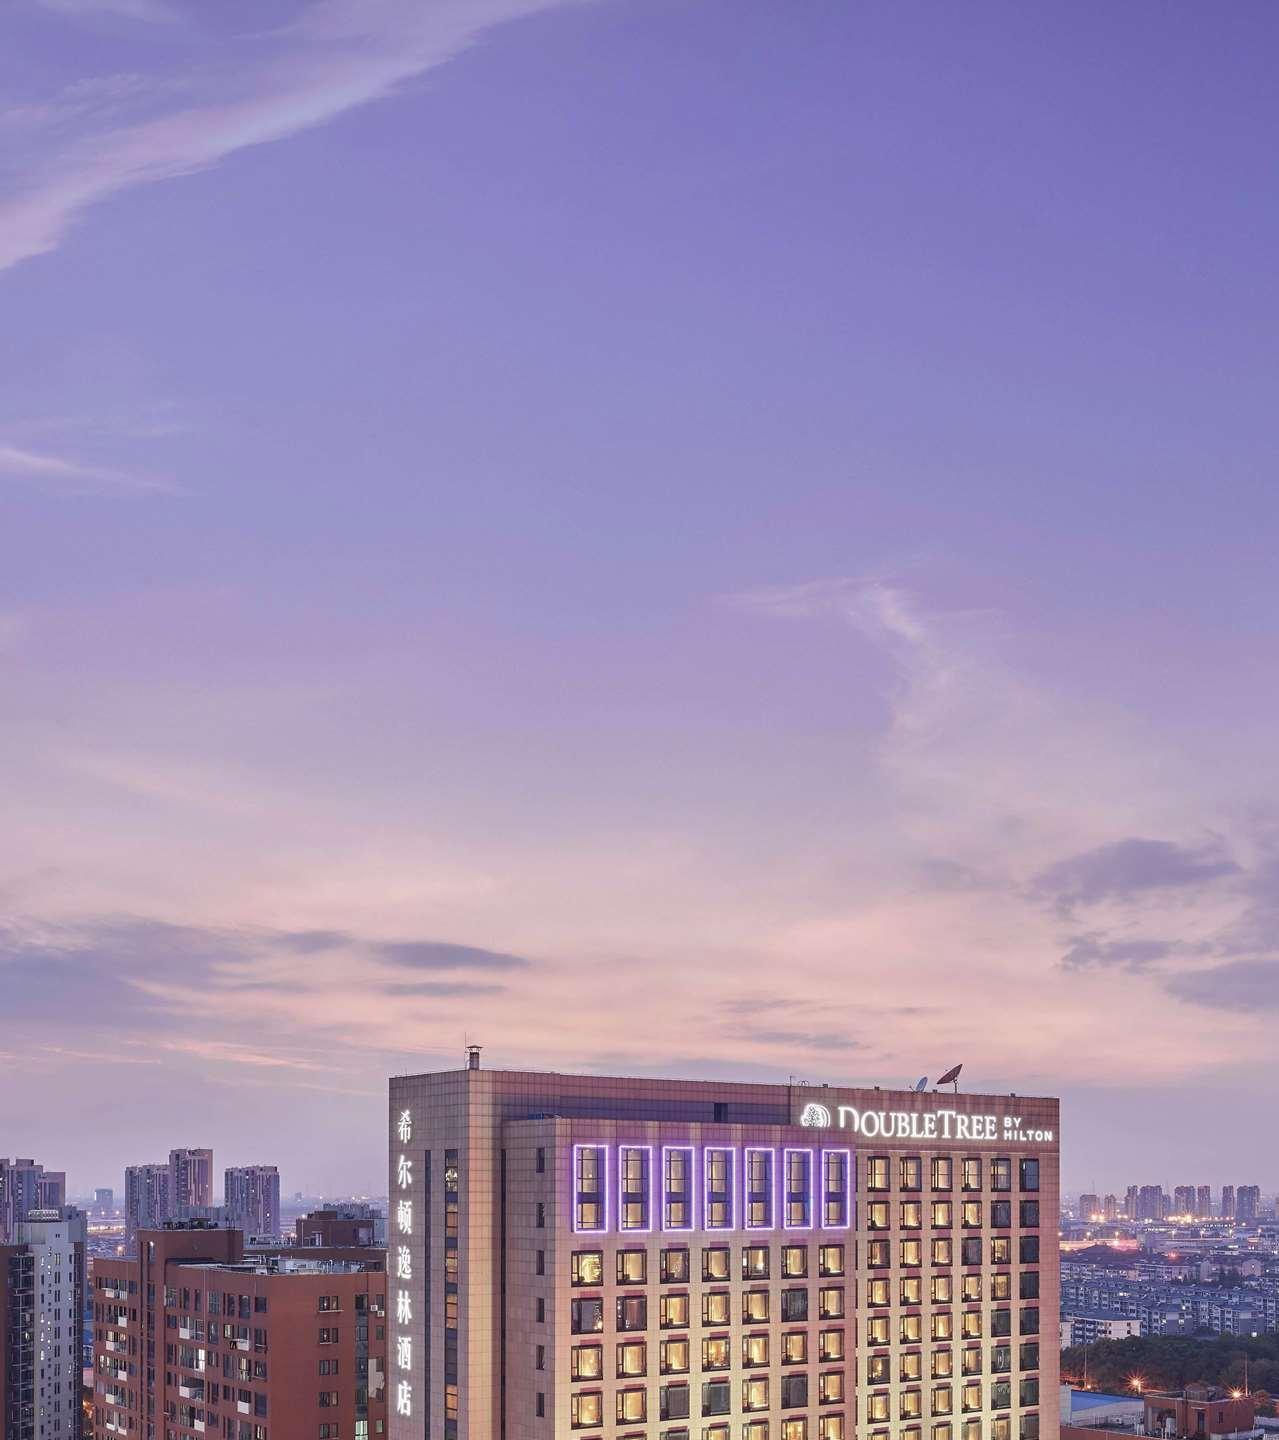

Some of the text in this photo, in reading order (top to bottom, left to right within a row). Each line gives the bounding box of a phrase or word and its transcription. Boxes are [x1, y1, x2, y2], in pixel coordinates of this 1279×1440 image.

[1004, 1117, 1021, 1128] BY
[1004, 1130, 1053, 1142] HILTON
[397, 1109, 413, 1417] 希尔顿逸林酒店
